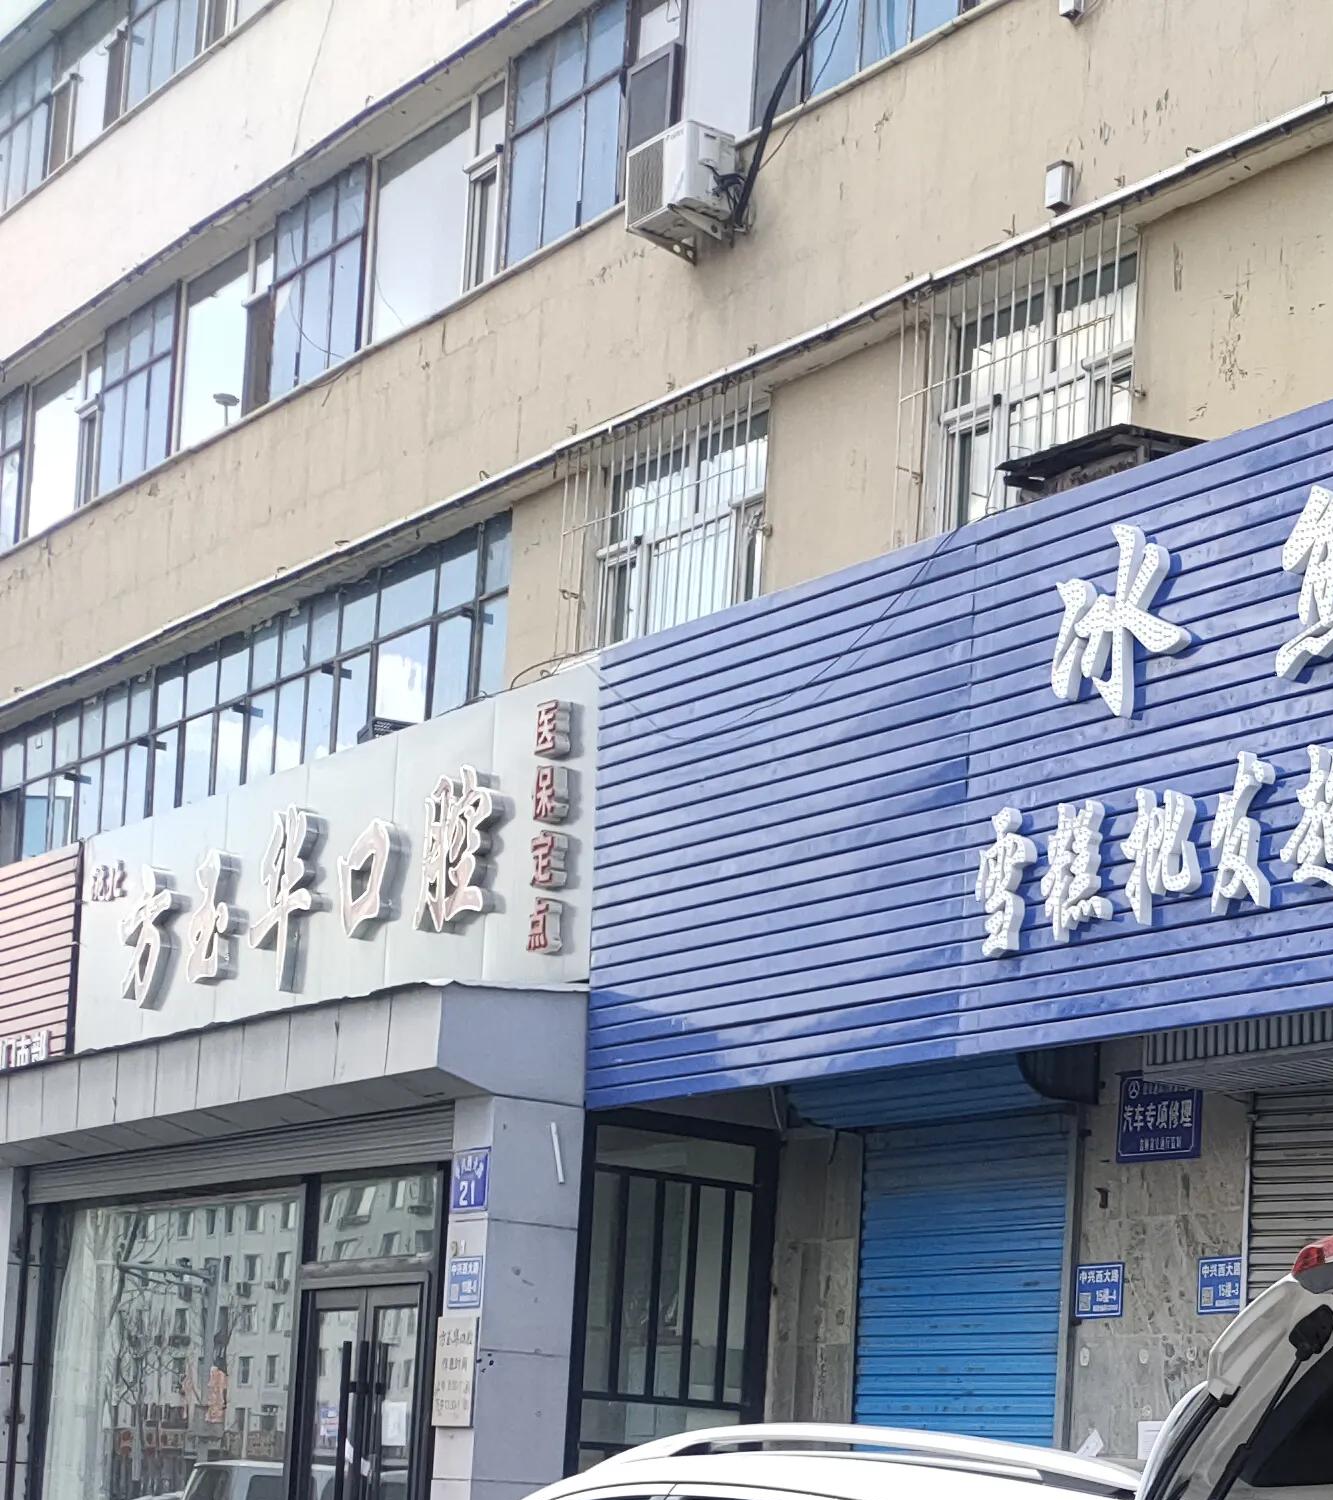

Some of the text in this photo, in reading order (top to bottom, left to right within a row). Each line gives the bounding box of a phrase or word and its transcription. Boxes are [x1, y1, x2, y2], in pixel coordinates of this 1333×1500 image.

[526, 699, 566, 952] 医保定点
[1122, 1100, 1193, 1133] 汽车专项修理
[459, 1180, 476, 1206] 21
[1079, 1268, 1120, 1284] 中兴西大路
[1201, 1261, 1241, 1279] 中兴西大路
